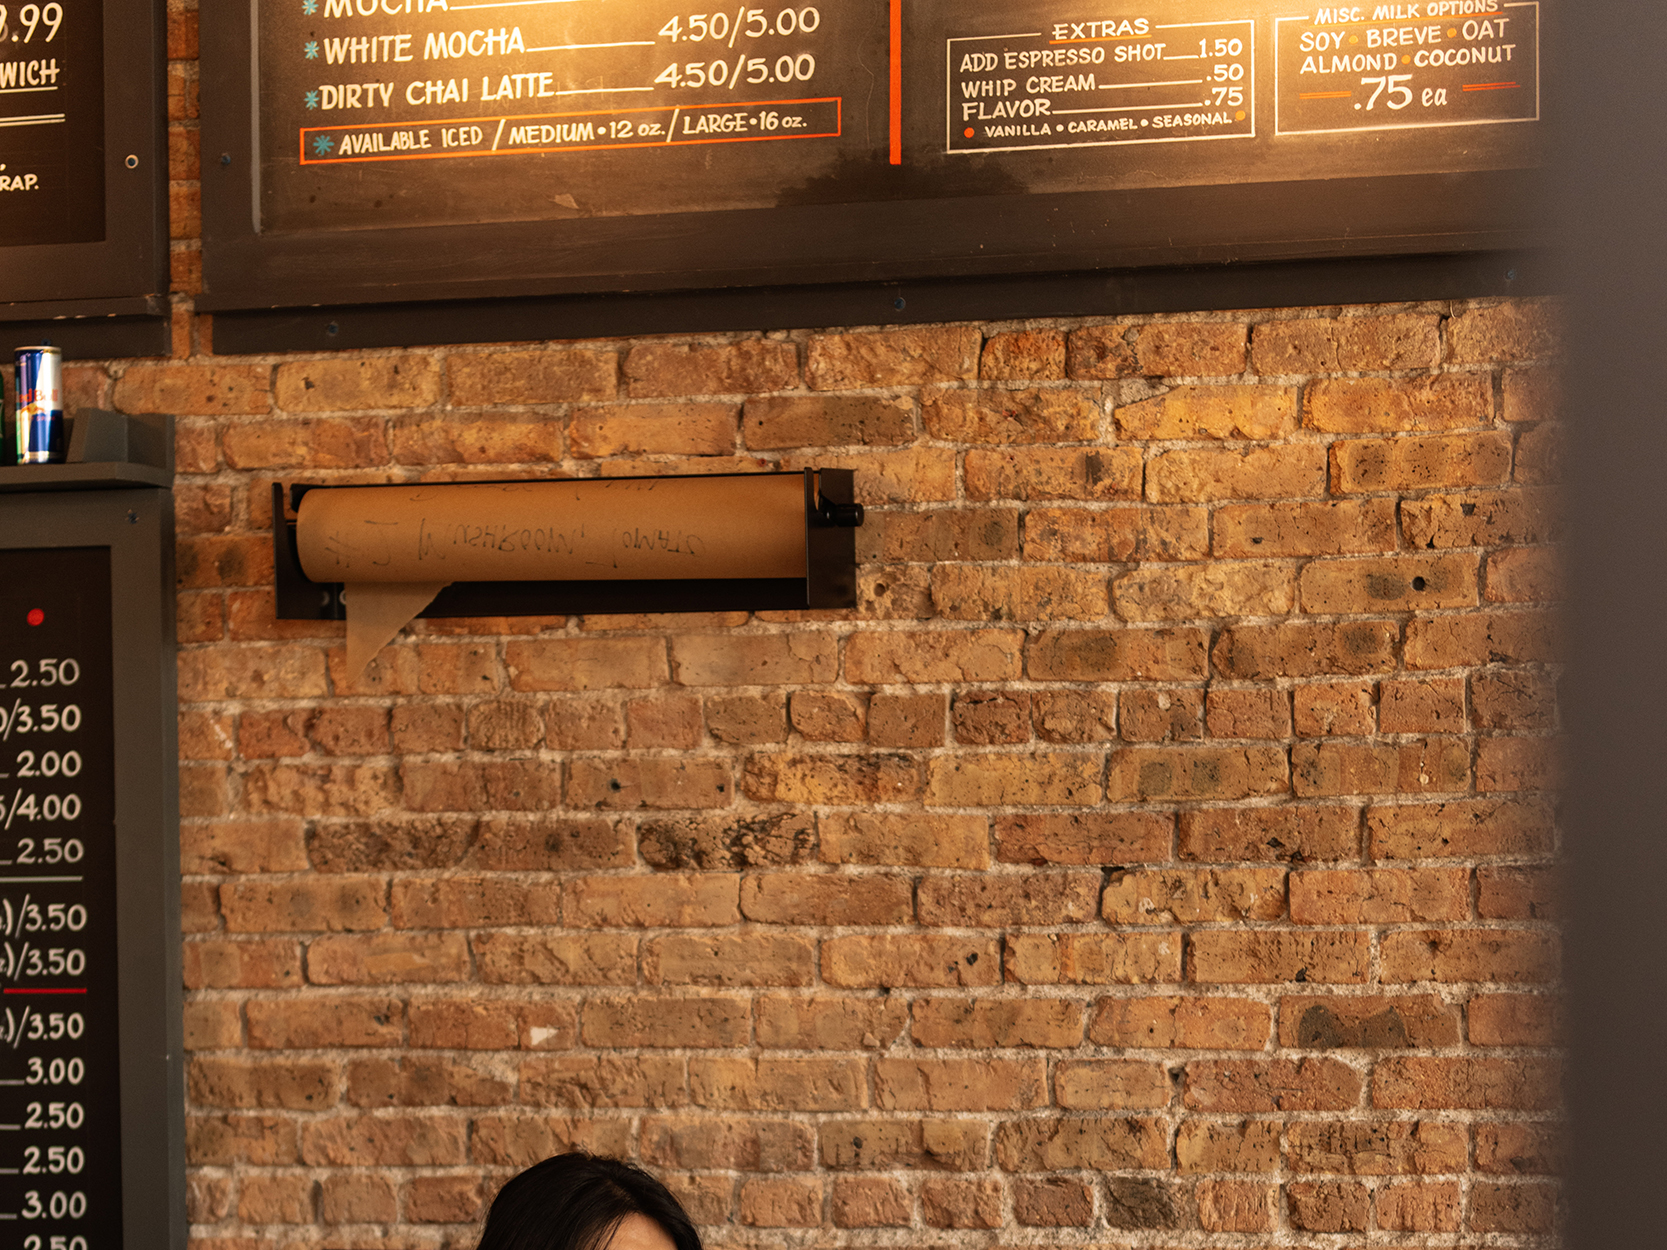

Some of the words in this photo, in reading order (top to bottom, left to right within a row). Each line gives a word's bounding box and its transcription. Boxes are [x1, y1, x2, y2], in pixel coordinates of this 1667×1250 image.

[1314, 7, 1364, 25] MISC.
[1372, 3, 1421, 20] MILK
[1427, 0, 1498, 16] OPTIONS
[323, 34, 413, 65] WHITE
[424, 27, 525, 60] MOCHA
[658, 6, 820, 48] 4.50/5.00
[1051, 18, 1150, 40] EXTRAS
[1299, 31, 1345, 51] SOY
[1366, 25, 1441, 48] BREVE
[1462, 18, 1509, 40] OAT
[960, 52, 998, 72] ADD
[1004, 47, 1105, 69] ESPRESSO
[1114, 43, 1166, 63] SHOT
[1199, 38, 1242, 59] 1.50
[1299, 53, 1397, 74] ALMOND
[1414, 44, 1516, 67] COCONUT
[318, 82, 394, 110] DIRTY
[405, 78, 469, 105] CHAI
[480, 72, 555, 101] LATTE
[654, 54, 815, 89] 4.50/5.00
[961, 79, 1016, 98] WHIP
[1025, 73, 1096, 93] CREAM
[1206, 63, 1244, 82] .50
[1354, 74, 1413, 110] .75
[1421, 87, 1448, 107] ea
[961, 98, 1051, 121] FLAVOR
[1204, 87, 1244, 106] .75
[338, 130, 431, 155] AVAILABLE
[441, 126, 483, 147] ICED
[782, 116, 807, 128] oz.
[985, 123, 1052, 138] VANILLA
[1067, 118, 1138, 134] CARAMEL
[1151, 112, 1232, 129] SEASONAL
[10, 658, 80, 688] 2.50
[16, 750, 82, 777] 2.00
[17, 838, 83, 864] 2.50
[26, 1057, 84, 1085] 3.00
[25, 1102, 84, 1129] 2.50
[23, 1146, 84, 1174] 2.50
[22, 1191, 87, 1219] 3.00
